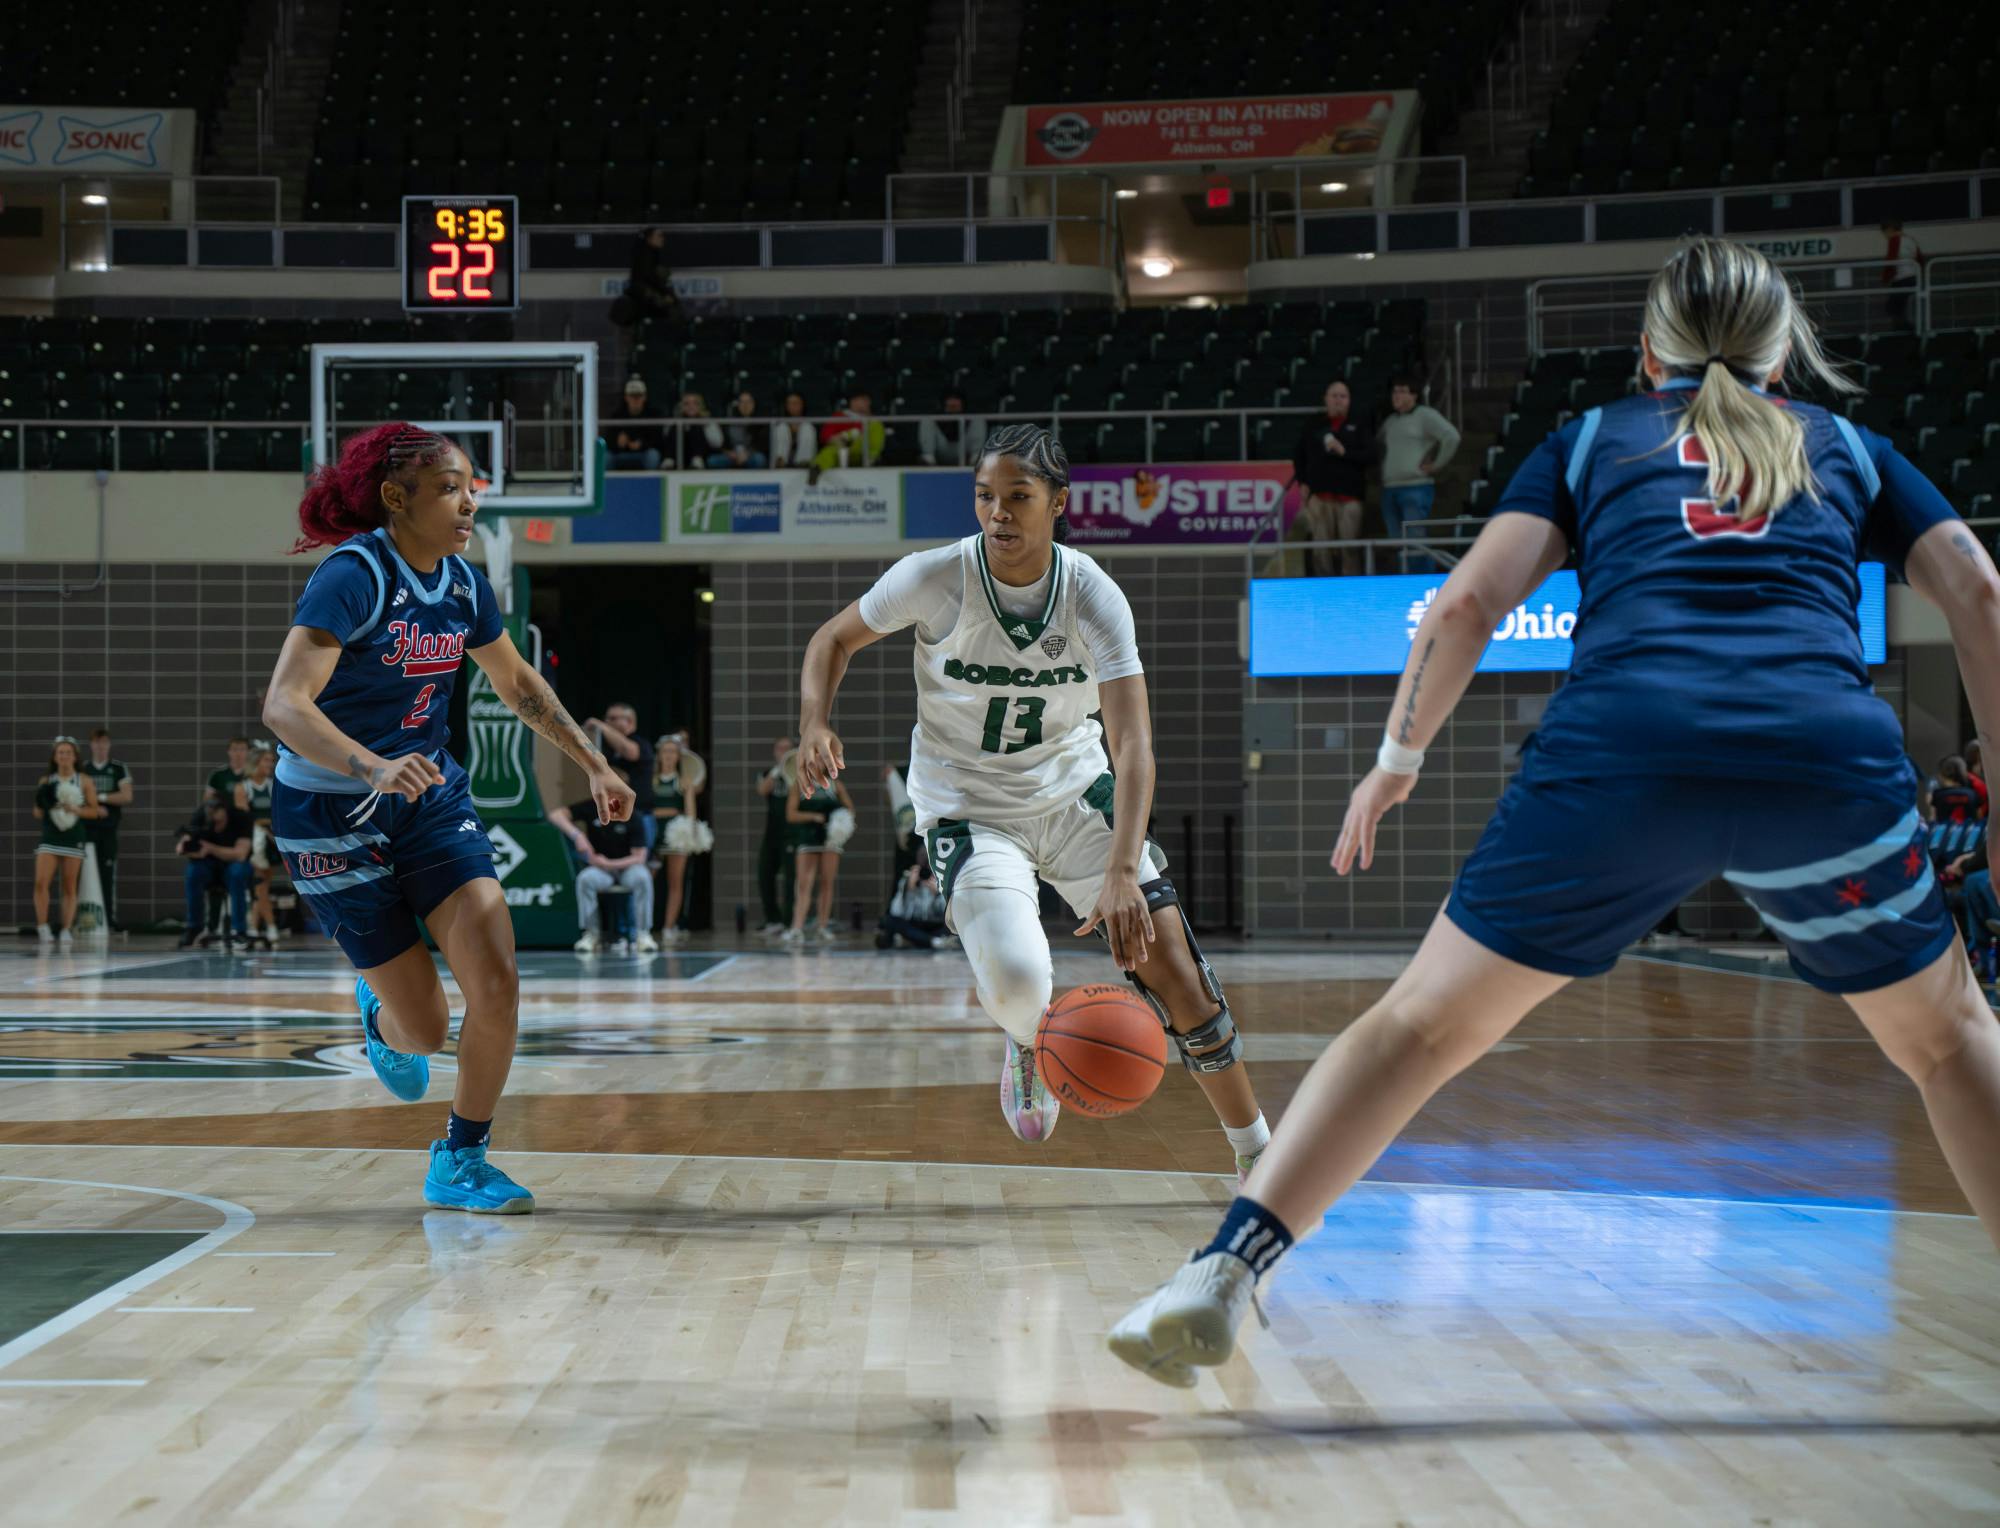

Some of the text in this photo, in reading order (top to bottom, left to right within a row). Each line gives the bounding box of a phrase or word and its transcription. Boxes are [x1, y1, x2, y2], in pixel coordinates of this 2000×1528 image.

[1102, 102, 1329, 127] NOW OPEN IN ATHENS!
[68, 131, 146, 151] SONIC
[1208, 123, 1245, 138] State
[1171, 139, 1256, 156] Athens, OH
[436, 209, 505, 241] 9:35
[1746, 238, 1832, 259] ERVED
[428, 243, 494, 298] 22
[798, 500, 888, 516] Athens, OH
[1069, 474, 1285, 527] TRUSTED
[382, 620, 468, 665] Flame
[1009, 629, 1033, 641] adidas
[944, 658, 1088, 688] BOBCATS
[401, 684, 436, 729] 2
[981, 696, 1047, 754] 13
